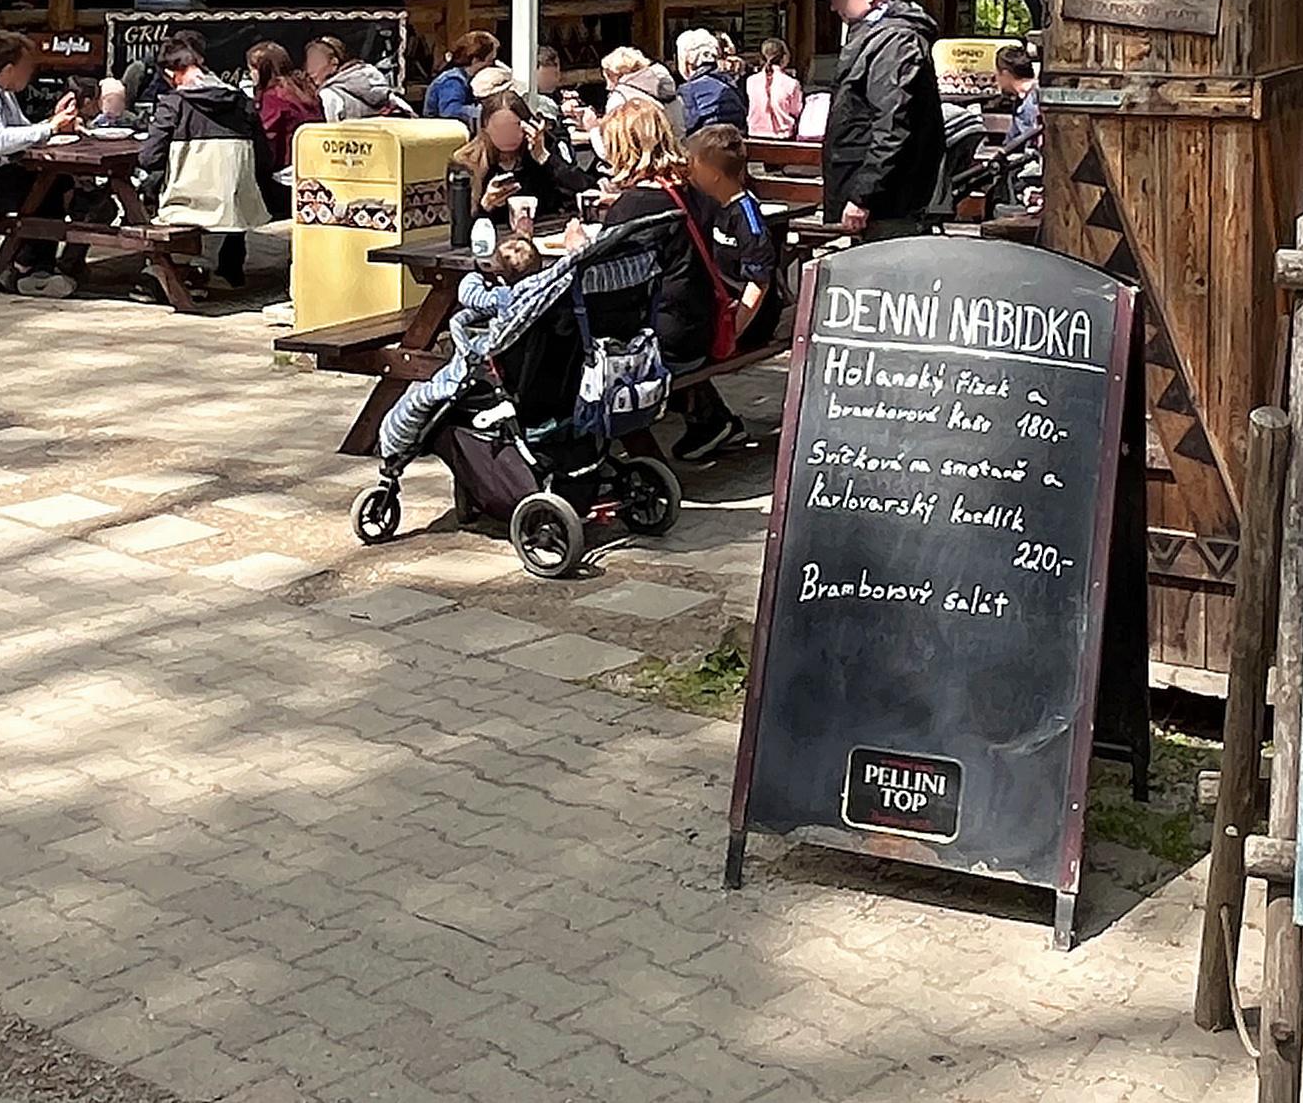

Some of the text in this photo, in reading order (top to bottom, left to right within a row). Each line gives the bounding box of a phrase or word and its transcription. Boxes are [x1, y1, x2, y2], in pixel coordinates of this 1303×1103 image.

[323, 140, 372, 155] ODPADKY
[822, 278, 942, 339] DENNÍ
[824, 347, 1048, 406] Holanský řízek a
[807, 439, 904, 473] Svíčková
[941, 459, 1028, 482] smetaně
[1043, 472, 1064, 488] a
[950, 494, 1025, 533] knedlík
[1013, 541, 1074, 577] 220,-
[799, 562, 1008, 617] Bramborový salát
[864, 764, 946, 796] PELLINI
[880, 788, 927, 812] TOP
